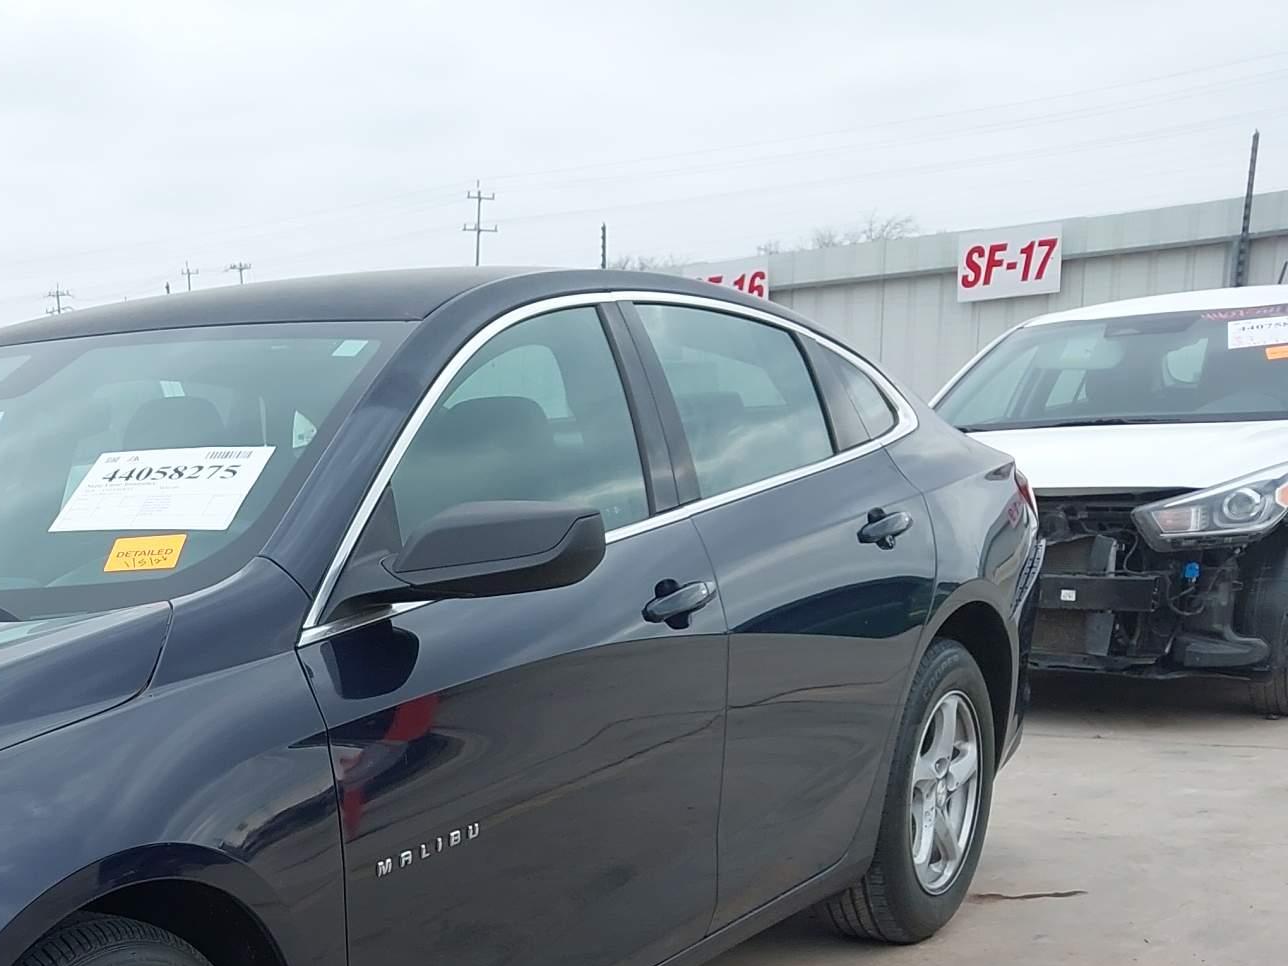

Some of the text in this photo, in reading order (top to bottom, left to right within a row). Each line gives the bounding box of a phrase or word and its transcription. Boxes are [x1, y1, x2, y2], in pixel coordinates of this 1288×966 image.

[961, 238, 1058, 288] SF-17
[102, 464, 241, 482] 44058275
[116, 548, 174, 558] DETAILED
[377, 822, 480, 878] MALIBU
